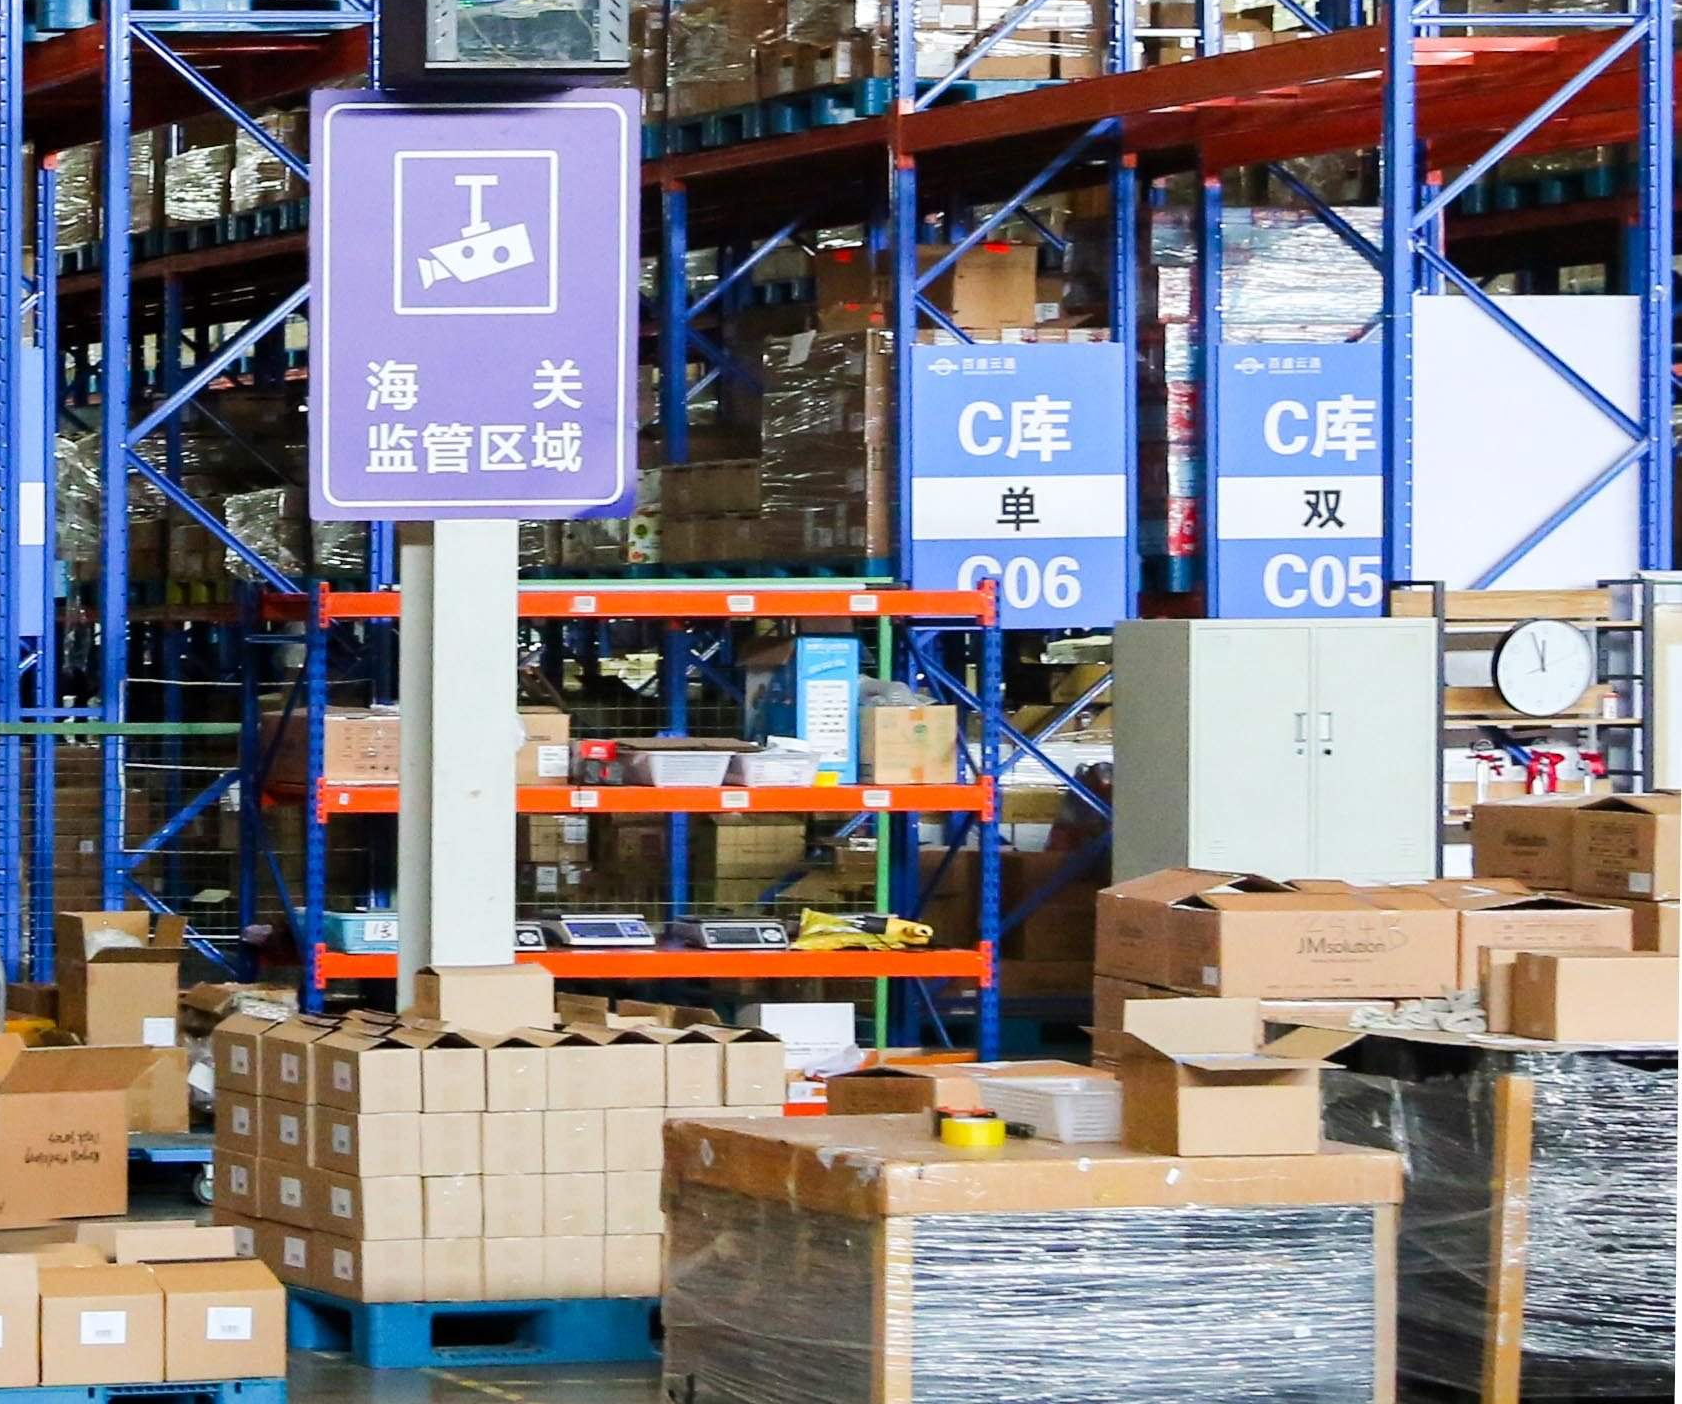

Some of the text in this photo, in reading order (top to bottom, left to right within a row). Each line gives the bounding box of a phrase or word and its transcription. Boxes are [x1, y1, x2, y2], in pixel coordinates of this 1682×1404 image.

[366, 360, 583, 412] 海 关
[366, 422, 583, 475] 监管区域
[958, 394, 1072, 462] C库
[1264, 394, 1376, 462] C库
[996, 486, 1040, 532] 单
[1302, 490, 1344, 528] 双
[1263, 553, 1384, 608] C05
